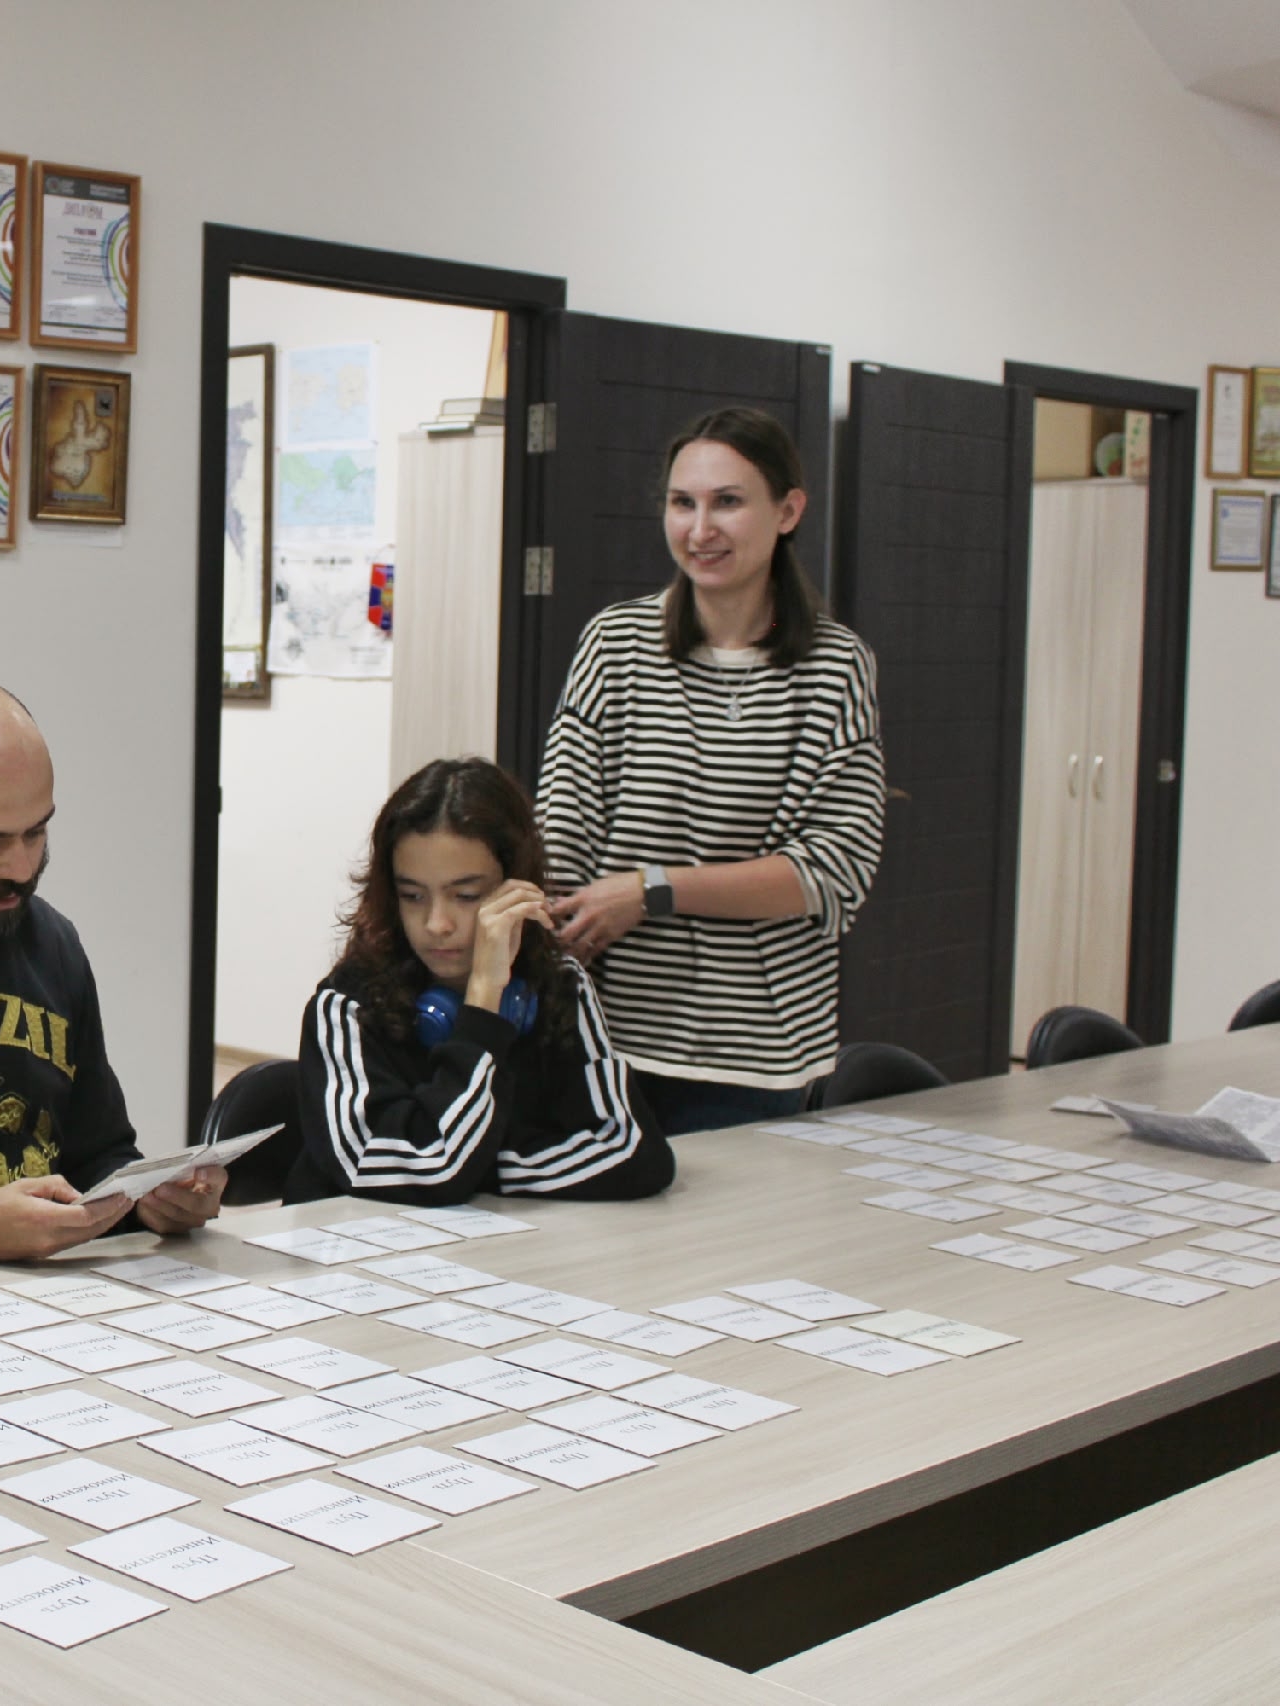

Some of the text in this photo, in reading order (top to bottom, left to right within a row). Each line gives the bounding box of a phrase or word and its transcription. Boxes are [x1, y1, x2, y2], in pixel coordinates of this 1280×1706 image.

[182, 1384, 222, 1396] Путь
[67, 1415, 109, 1429] Путь
[549, 1451, 590, 1465] Путь
[385, 1462, 474, 1490] Иннокентия
[431, 1476, 473, 1491] Путь
[38, 1472, 134, 1505] Иннокентия
[86, 1487, 131, 1504] Путь
[274, 1493, 367, 1528] Иннокентия
[324, 1510, 369, 1529] Путь
[118, 1534, 221, 1571] Иннокентия
[171, 1552, 219, 1571] Путь
[39, 1594, 89, 1616] Путь
